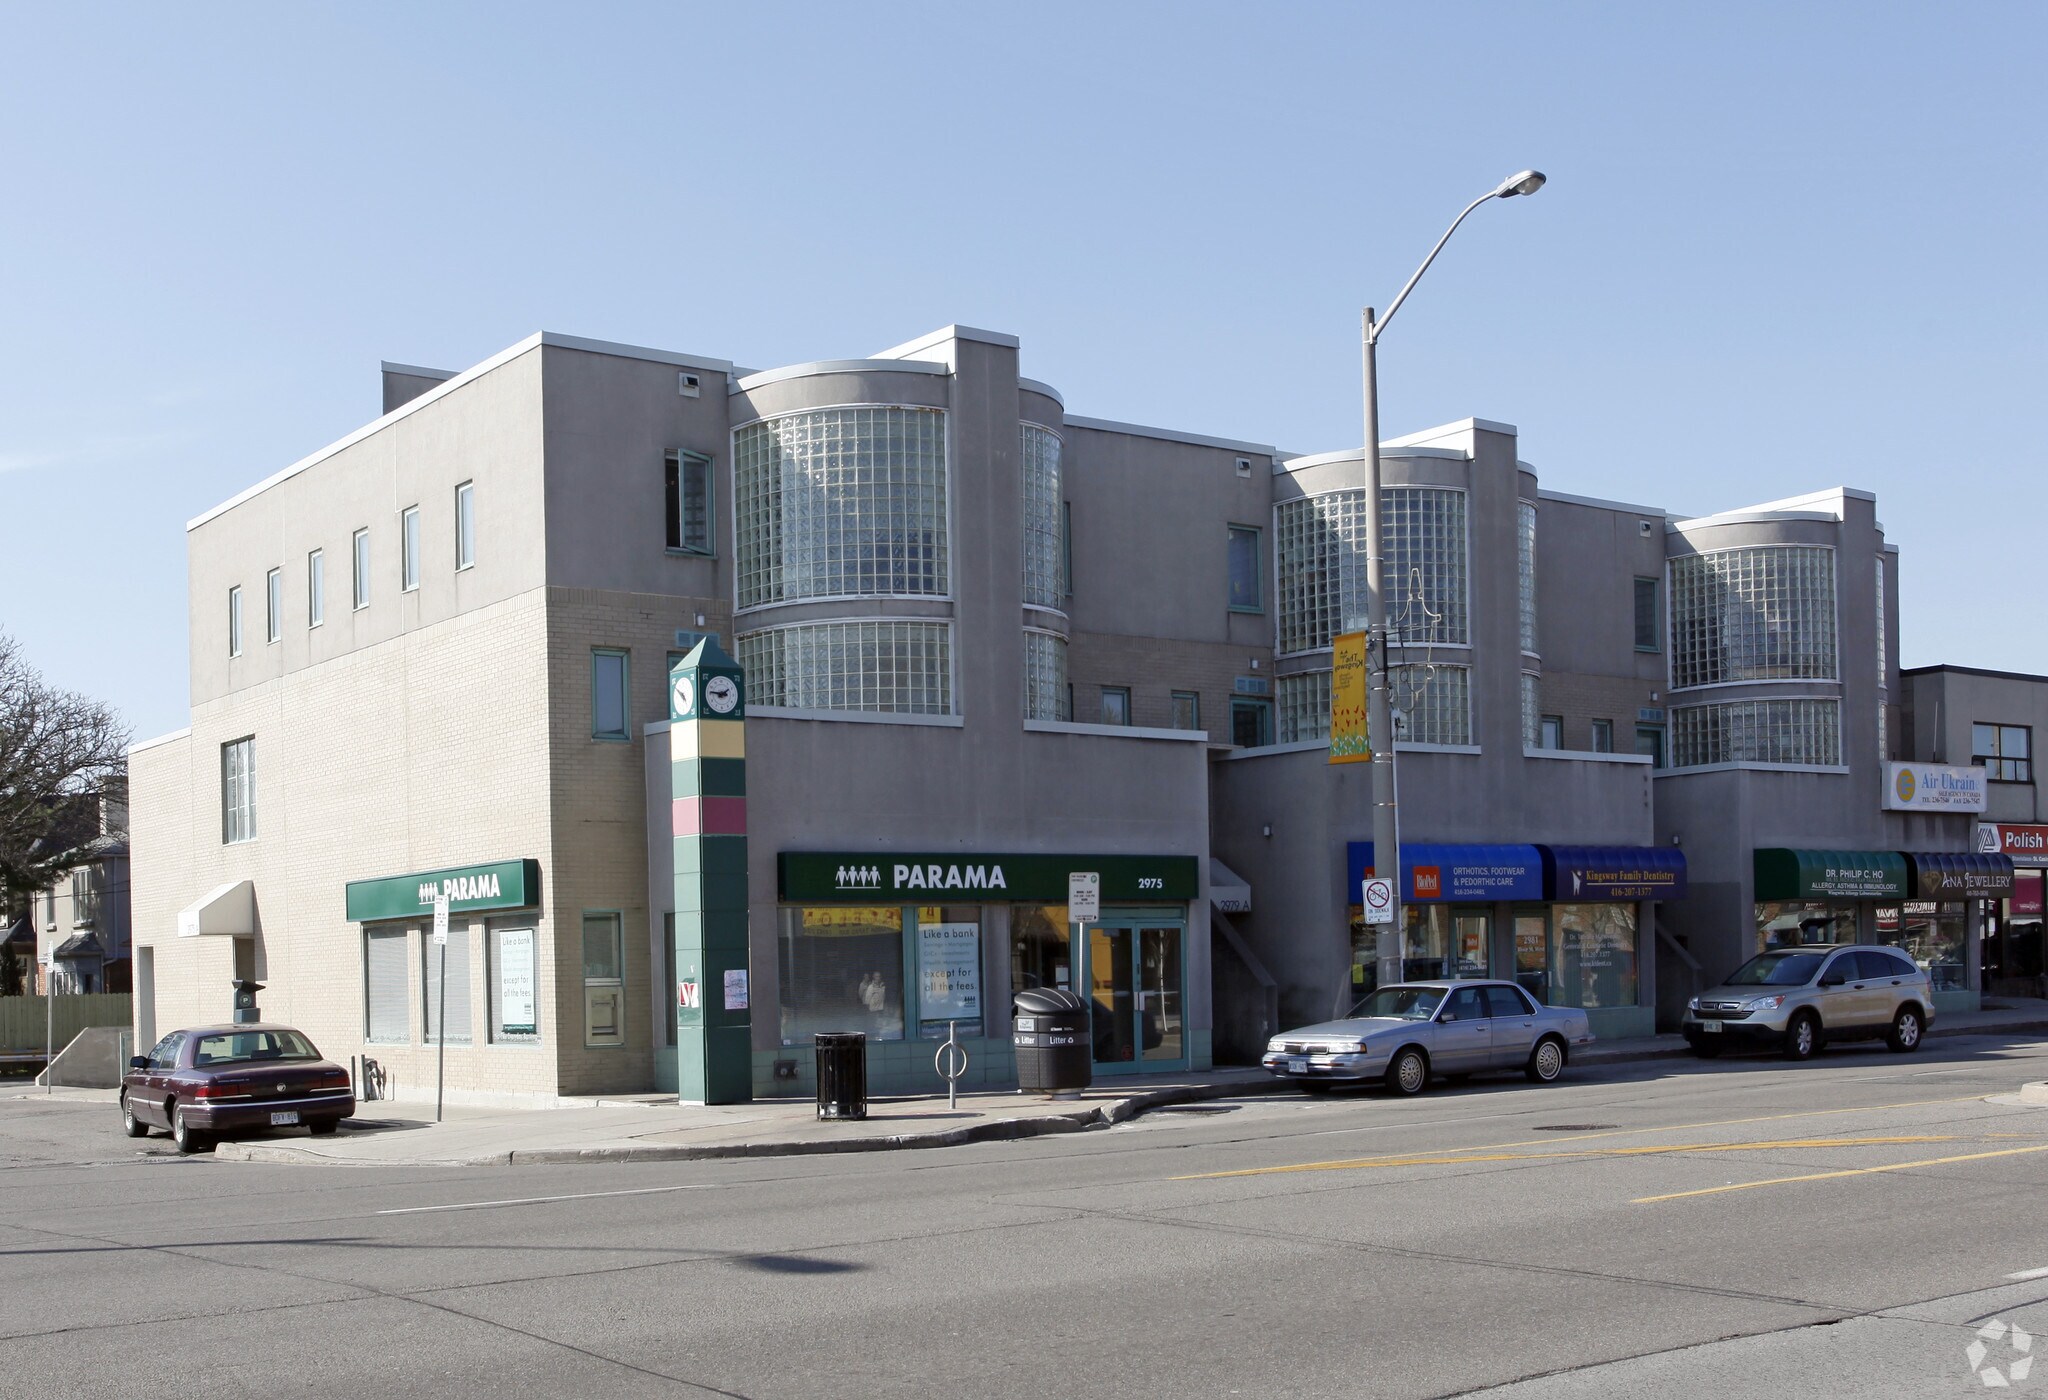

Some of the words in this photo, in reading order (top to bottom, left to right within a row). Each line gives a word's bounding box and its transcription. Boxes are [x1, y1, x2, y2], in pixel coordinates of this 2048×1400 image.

[1922, 773, 1938, 788] Air
[2005, 832, 2043, 848] Polish
[1491, 867, 1525, 875] FOOTWEAR
[1586, 870, 1618, 882] Kingsway
[1620, 870, 1642, 882] Family
[1644, 870, 1675, 882] Dentistry
[1826, 869, 1838, 878] DR.
[1840, 870, 1862, 878] PHILIP
[1864, 870, 1871, 878] C.
[1872, 870, 1884, 878] HO
[894, 865, 1007, 889] PARAMA
[1416, 874, 1437, 889] BioPed
[1454, 878, 1460, 886] &
[1460, 878, 1496, 886] PEDORTHIC
[1497, 878, 1513, 886] CARE
[1942, 872, 1962, 888] ANA
[1964, 872, 2011, 888] JEWELLERY
[443, 873, 501, 901] PARAMA
[1138, 878, 1163, 889] 2975
[1611, 888, 1652, 896] 416-207-1377
[1221, 900, 1240, 911] 2979
[1243, 900, 1250, 911] A
[924, 930, 942, 939] Like
[952, 928, 975, 938] bank
[502, 937, 512, 946] Like
[518, 935, 531, 945] bank
[924, 970, 955, 980] except
[958, 968, 972, 977] for
[504, 976, 520, 986] except
[520, 974, 529, 984] for
[924, 982, 936, 992] all
[939, 982, 954, 991] the
[956, 982, 976, 991] fees.
[510, 989, 518, 998] the
[1022, 1036, 1035, 1044] Litter
[1050, 1036, 1066, 1044] Litter
